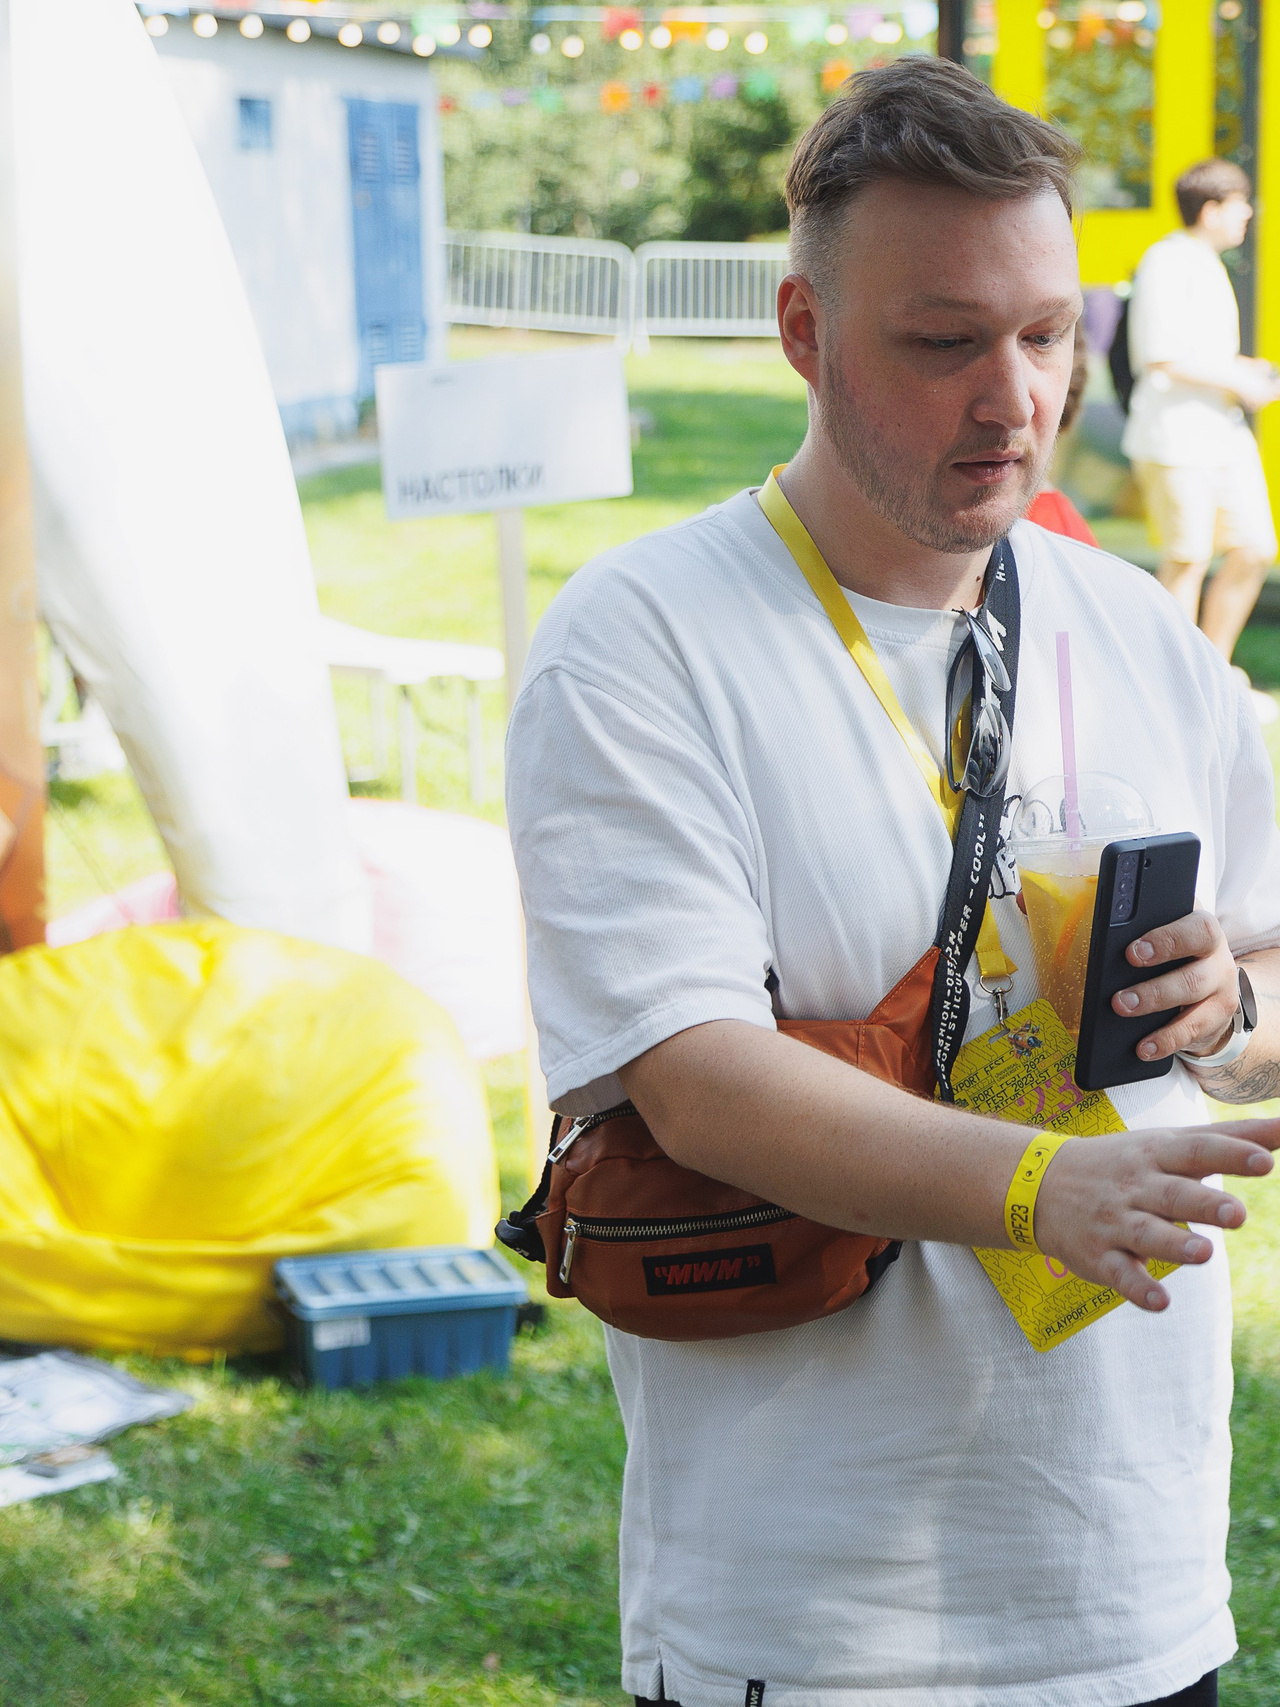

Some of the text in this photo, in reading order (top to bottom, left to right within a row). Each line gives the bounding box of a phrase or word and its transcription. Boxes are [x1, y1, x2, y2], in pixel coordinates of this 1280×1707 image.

[1054, 1053, 1077, 1073] 2023
[986, 1089, 1009, 1109] FEST
[1011, 1073, 1035, 1093] 2023
[1051, 1094, 1101, 1129] FEST 2023
[1011, 1204, 1033, 1245] PPF23
[1045, 1287, 1116, 1338] PLAYPORT FEST
